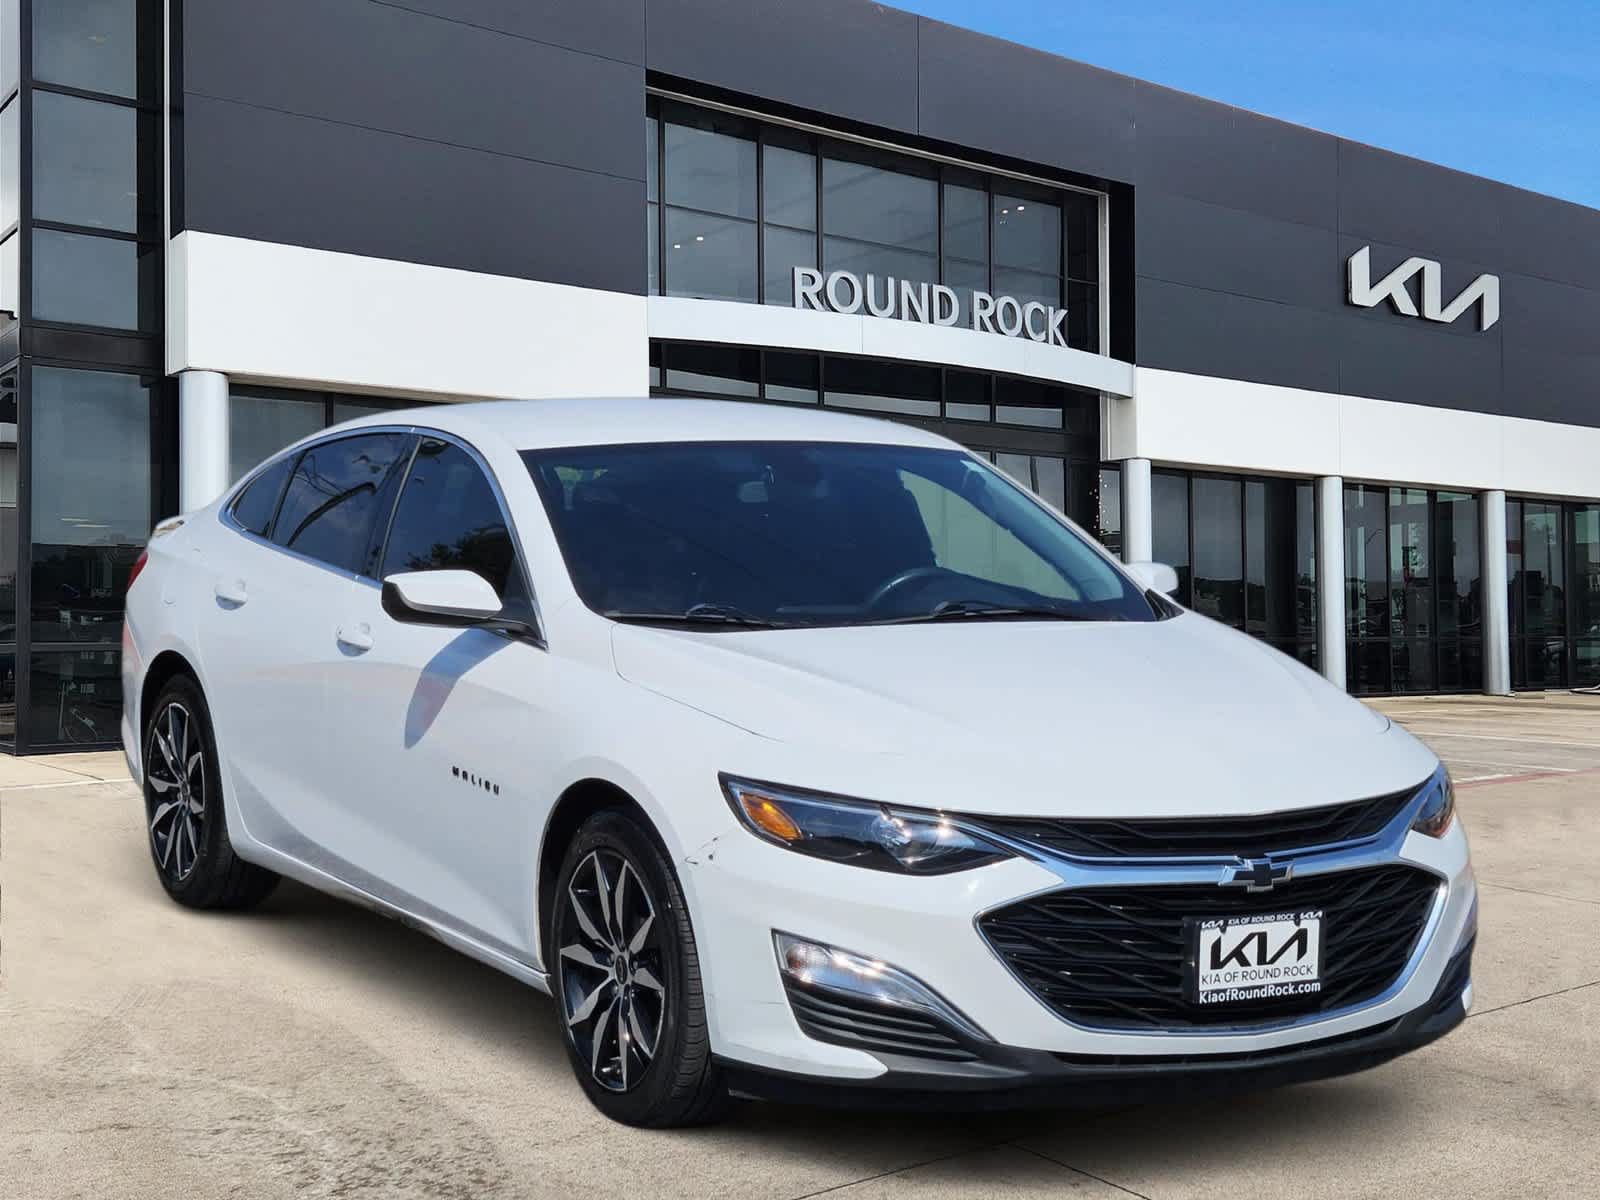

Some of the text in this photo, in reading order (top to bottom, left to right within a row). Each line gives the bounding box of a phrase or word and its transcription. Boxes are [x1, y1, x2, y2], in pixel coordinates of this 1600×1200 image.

[1347, 245, 1500, 332] KIA
[793, 266, 1069, 348] ROUND ROCK
[452, 766, 500, 796] MALIBU
[1227, 917, 1240, 926] KIA
[1240, 916, 1250, 925] OF
[1251, 914, 1276, 923] ROUND
[1276, 912, 1296, 921] ROCK
[1210, 927, 1308, 971] KIA
[1201, 964, 1313, 985] KIA OF ROUND ROCK
[1199, 981, 1321, 1005] KiaofRoundRock.com
